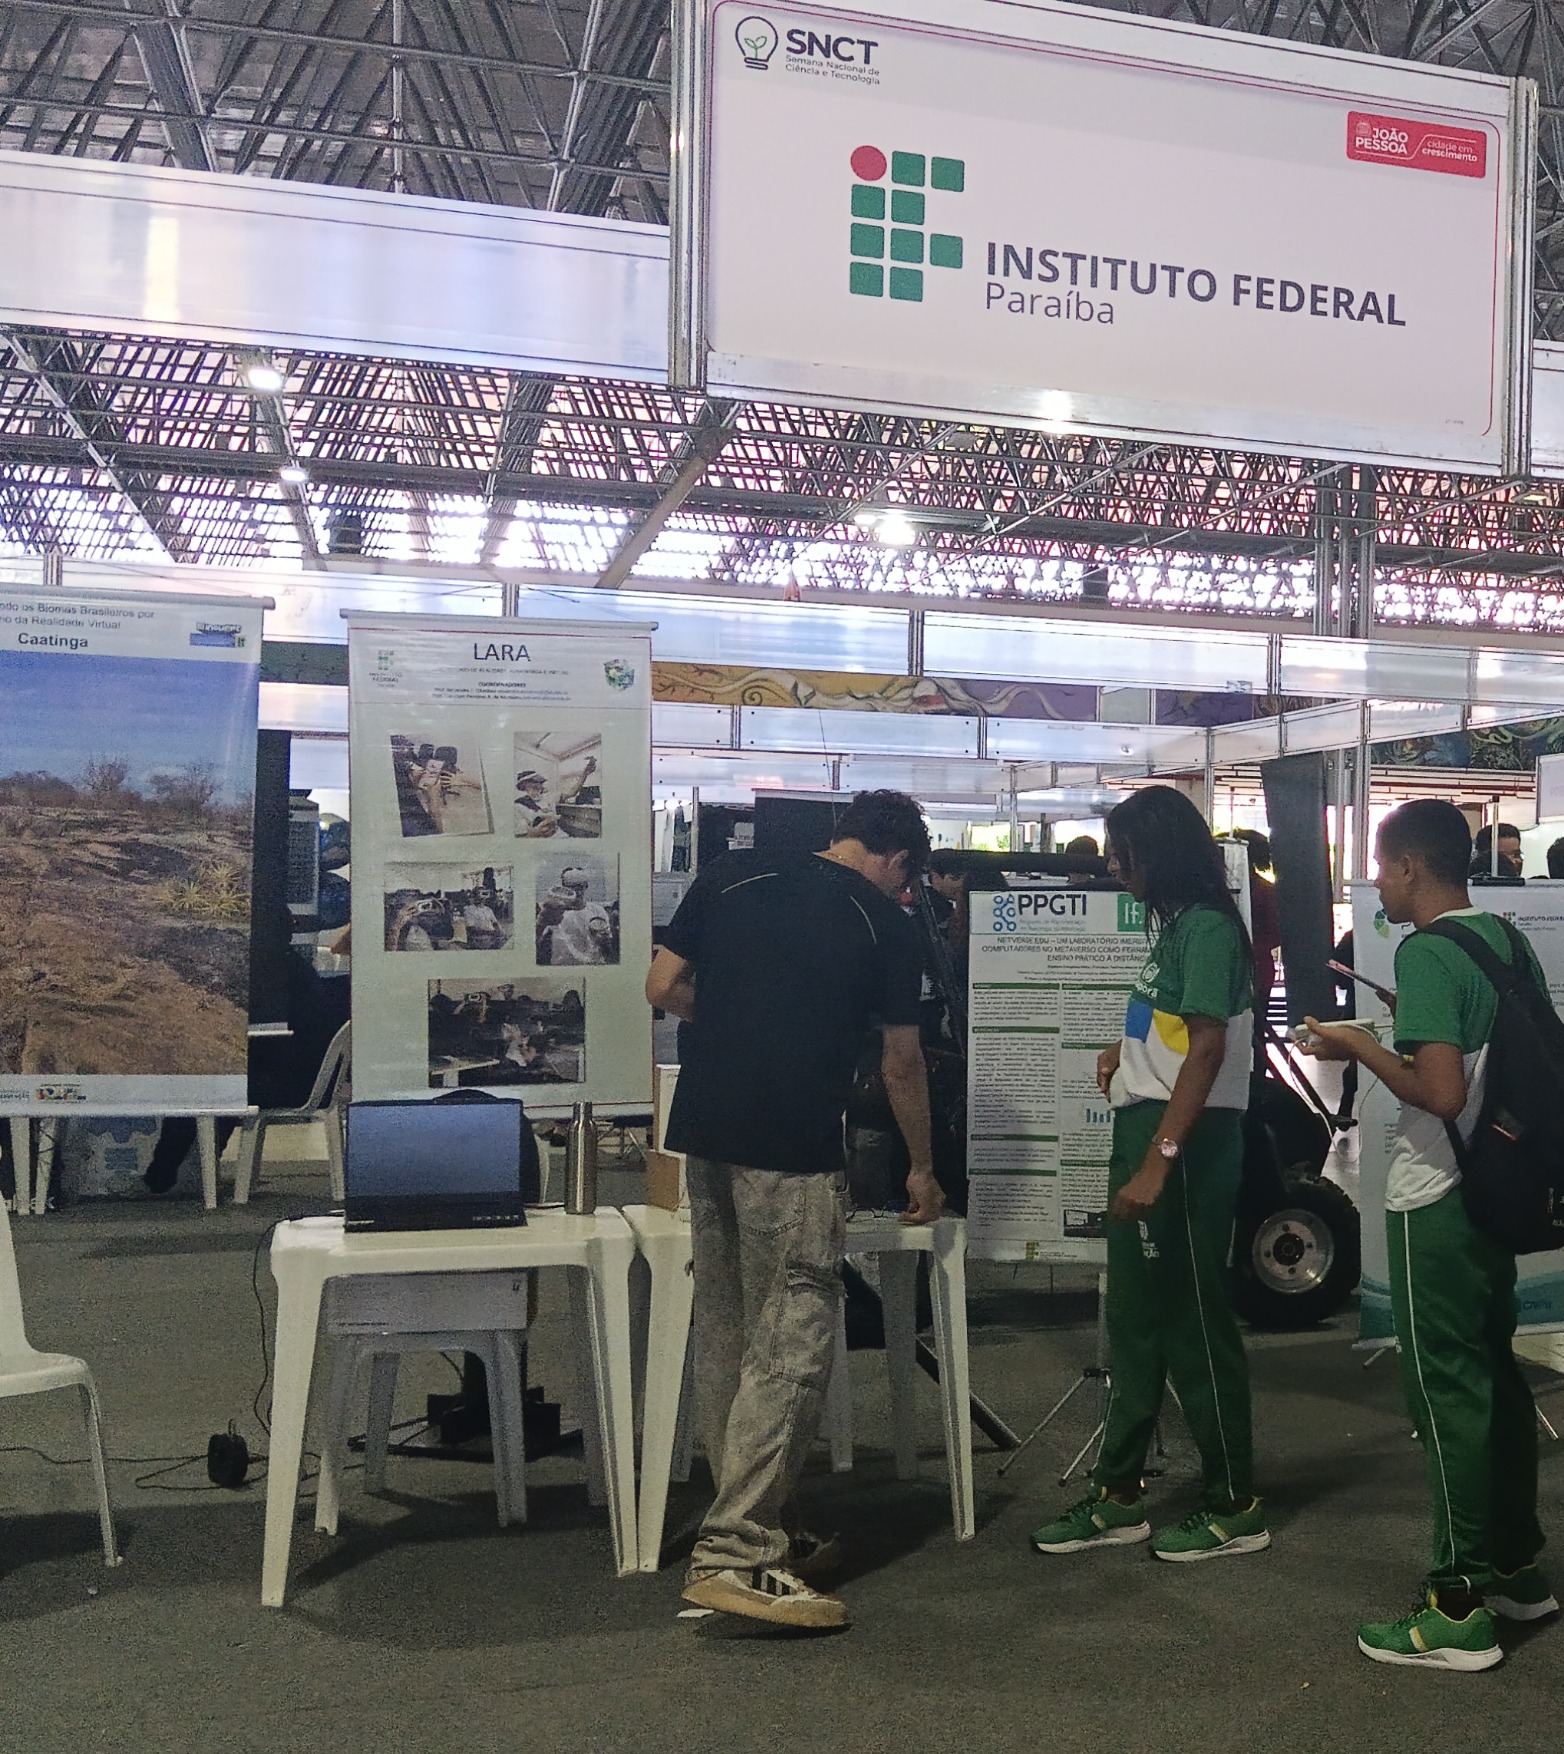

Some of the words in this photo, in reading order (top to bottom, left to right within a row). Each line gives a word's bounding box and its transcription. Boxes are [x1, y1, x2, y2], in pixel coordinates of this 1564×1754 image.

[786, 28, 879, 65] SNCT
[785, 55, 824, 68] Semana
[826, 61, 866, 74] Nacional
[868, 65, 880, 76] de
[785, 64, 820, 76] Ciência
[831, 70, 880, 86] Tecnologia
[1372, 127, 1409, 143] JOÃO
[1355, 137, 1408, 155] PESSOA
[1421, 147, 1478, 162] crescimento
[1427, 140, 1457, 150] cidade
[1459, 145, 1473, 154] em
[987, 242, 1217, 302] INSTITUTO
[1232, 274, 1407, 327] FEDERAL
[985, 281, 1115, 325] Paraíba
[37, 603, 77, 614] Biomas
[80, 605, 135, 617] Brasileiros
[138, 610, 155, 619] por
[14, 615, 28, 624] da
[32, 616, 84, 627] Realidade
[88, 619, 121, 629] Virtual
[17, 632, 88, 650] Caatinga
[473, 643, 531, 662] LARA
[1018, 893, 1087, 916] PPGTI
